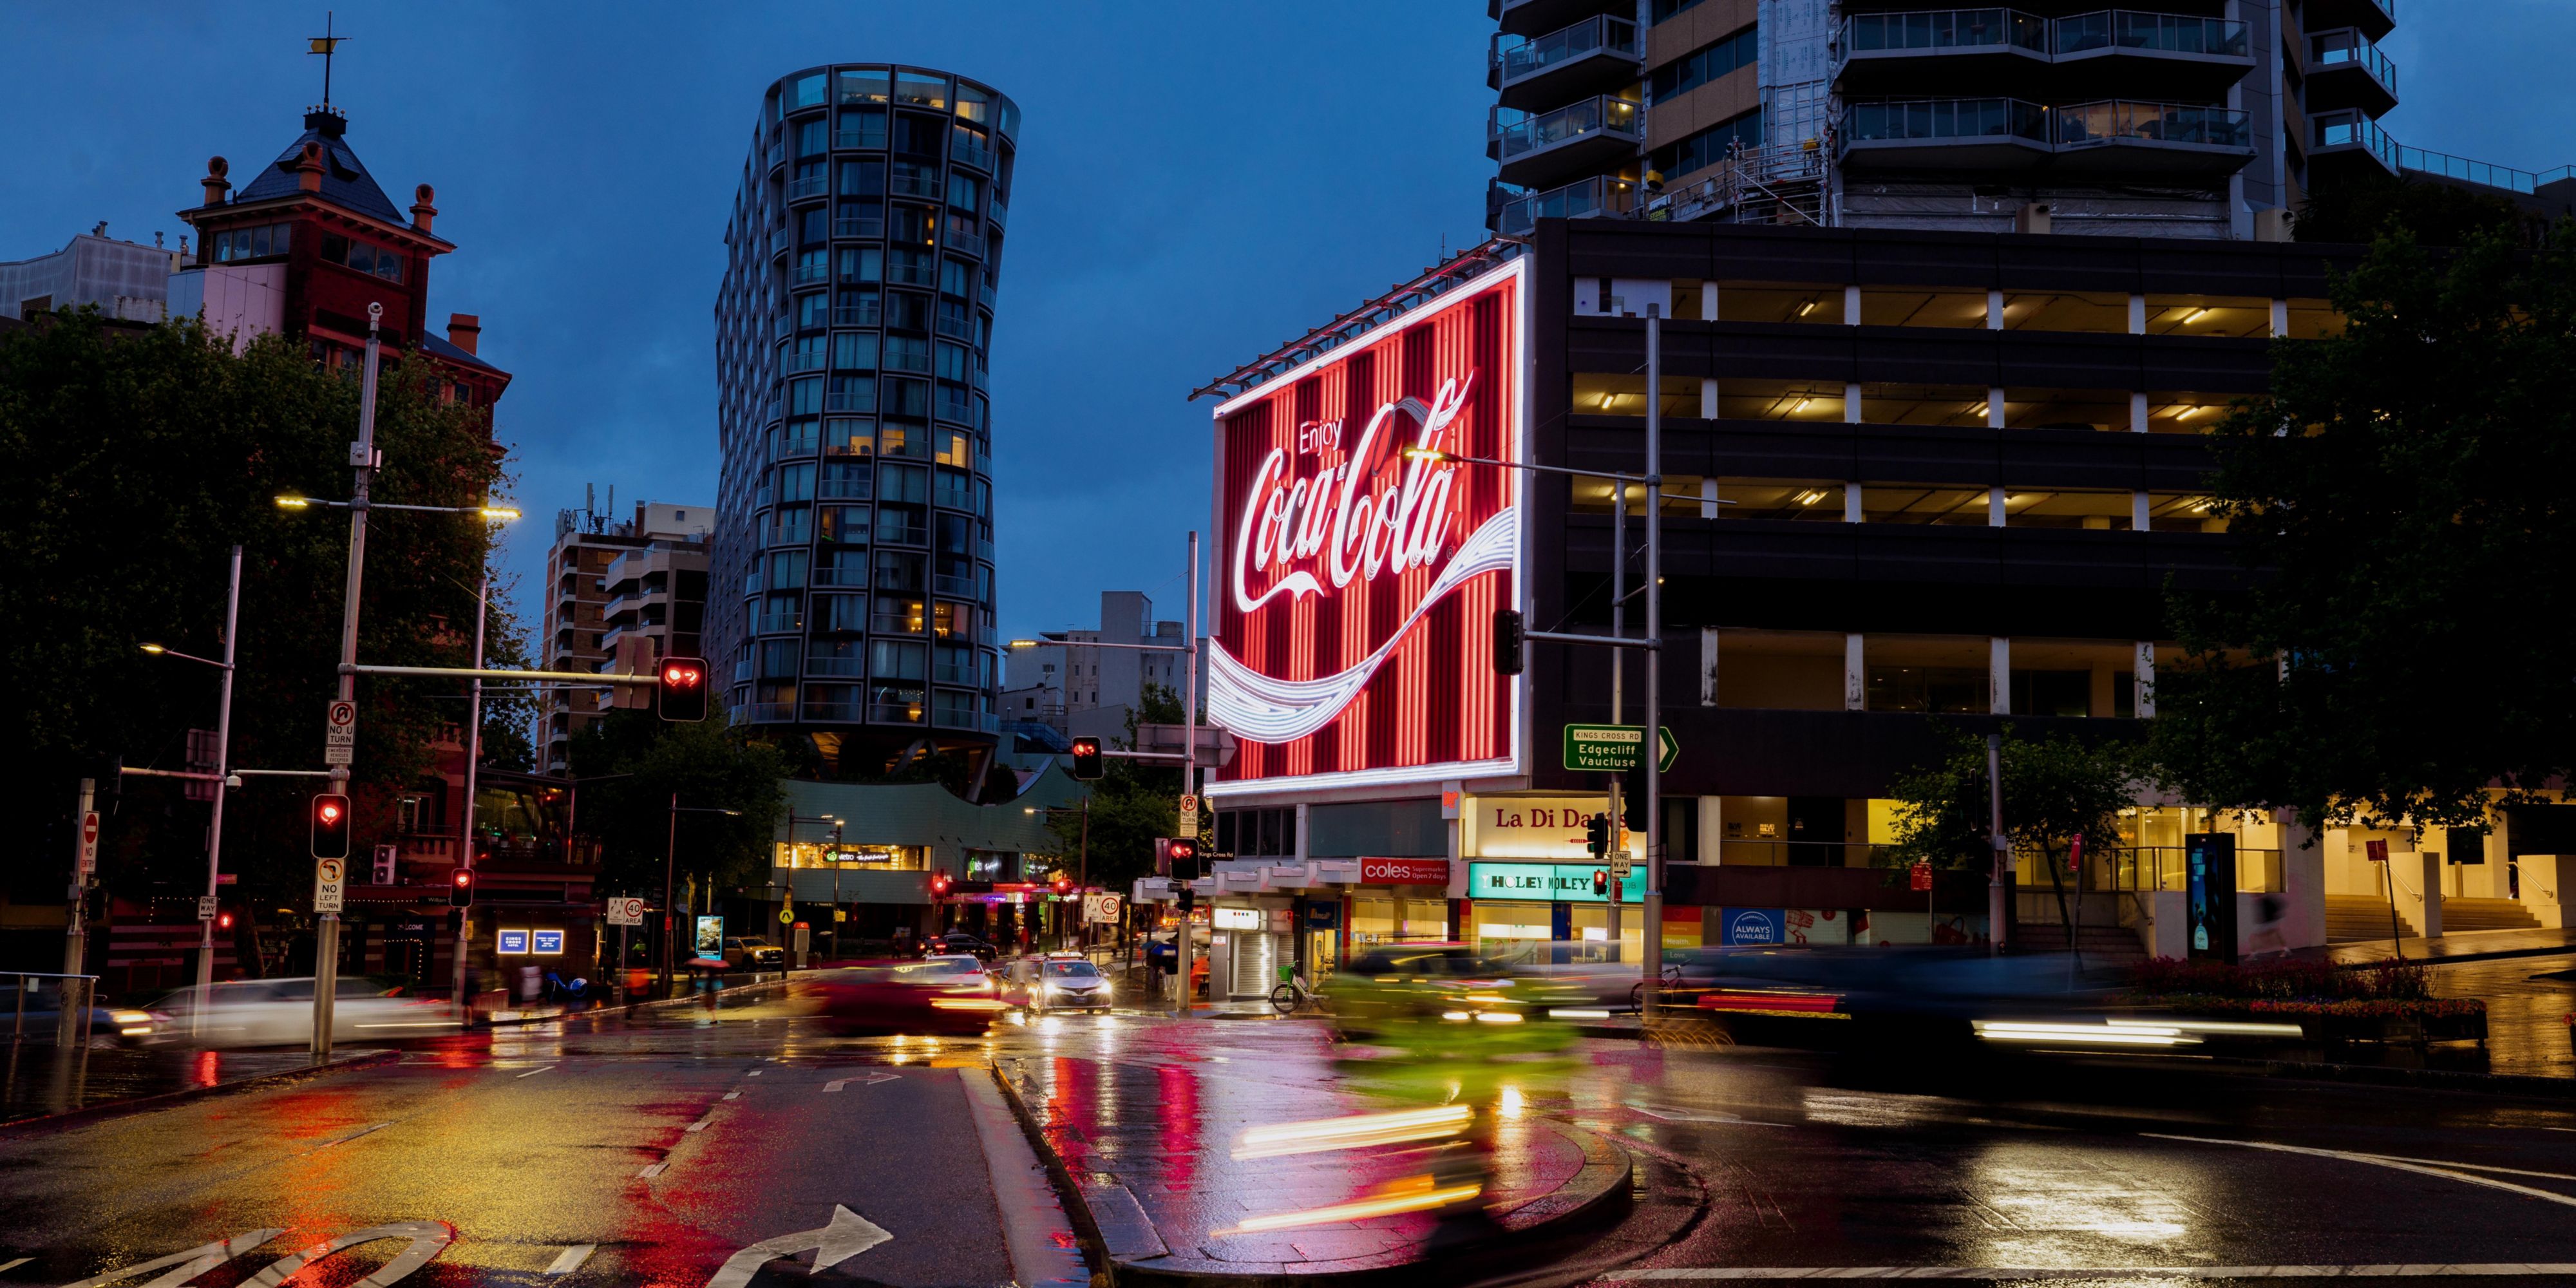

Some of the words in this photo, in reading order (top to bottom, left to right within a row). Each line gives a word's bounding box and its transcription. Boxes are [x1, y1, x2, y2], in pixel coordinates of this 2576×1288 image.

[1300, 419, 1343, 456] Enjoy
[1235, 367, 1475, 612] Coca-Cola
[329, 726, 342, 734] NO
[346, 726, 353, 734] U
[1579, 744, 1636, 757] Edgecliff
[1578, 756, 1636, 766] Vaucluse
[1495, 809, 1524, 828] La
[1531, 809, 1555, 828] Di
[86, 847, 93, 856] NO
[1365, 862, 1410, 878] coles
[322, 884, 337, 893] NO
[1492, 875, 1543, 889] HOLEY
[1548, 876, 1590, 890] MOLEY
[628, 904, 640, 913] 40
